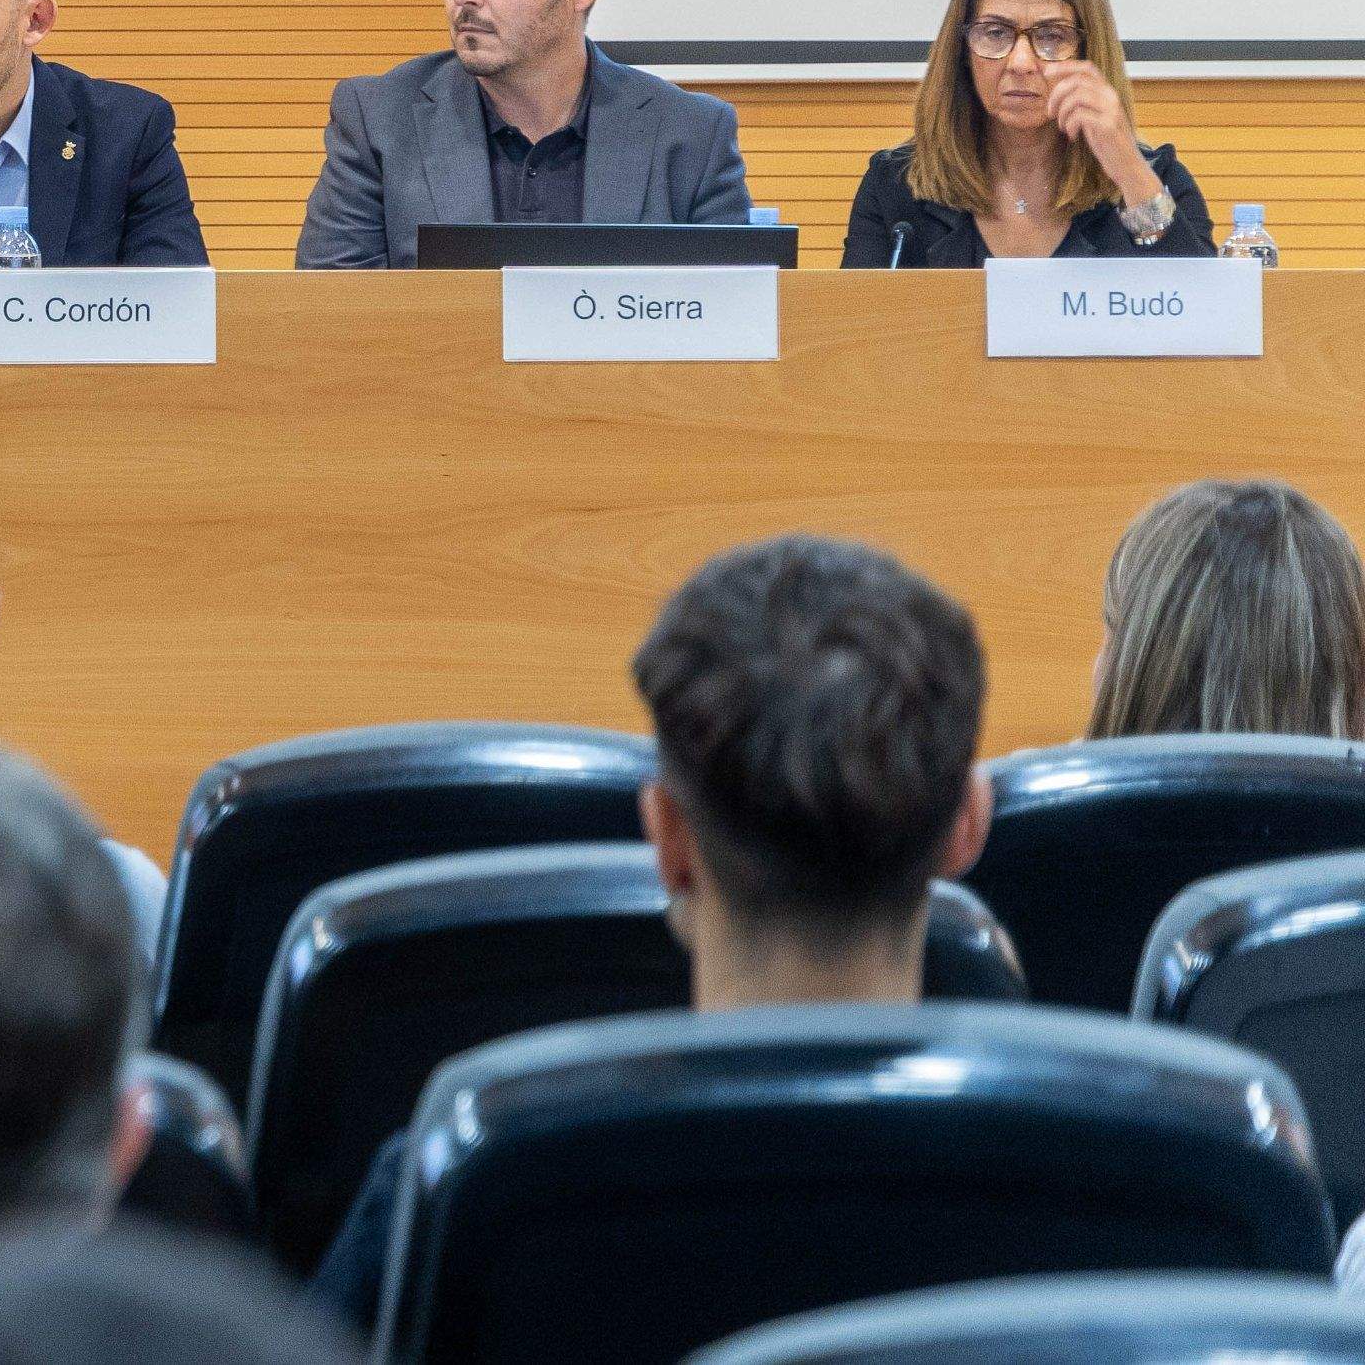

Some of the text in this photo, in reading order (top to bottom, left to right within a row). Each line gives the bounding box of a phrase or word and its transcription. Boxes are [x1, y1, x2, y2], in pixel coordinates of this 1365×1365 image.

[3, 297, 151, 323] C. Cordón
[572, 288, 703, 320] Ò. Sierra
[1062, 291, 1184, 317] M. Budó
